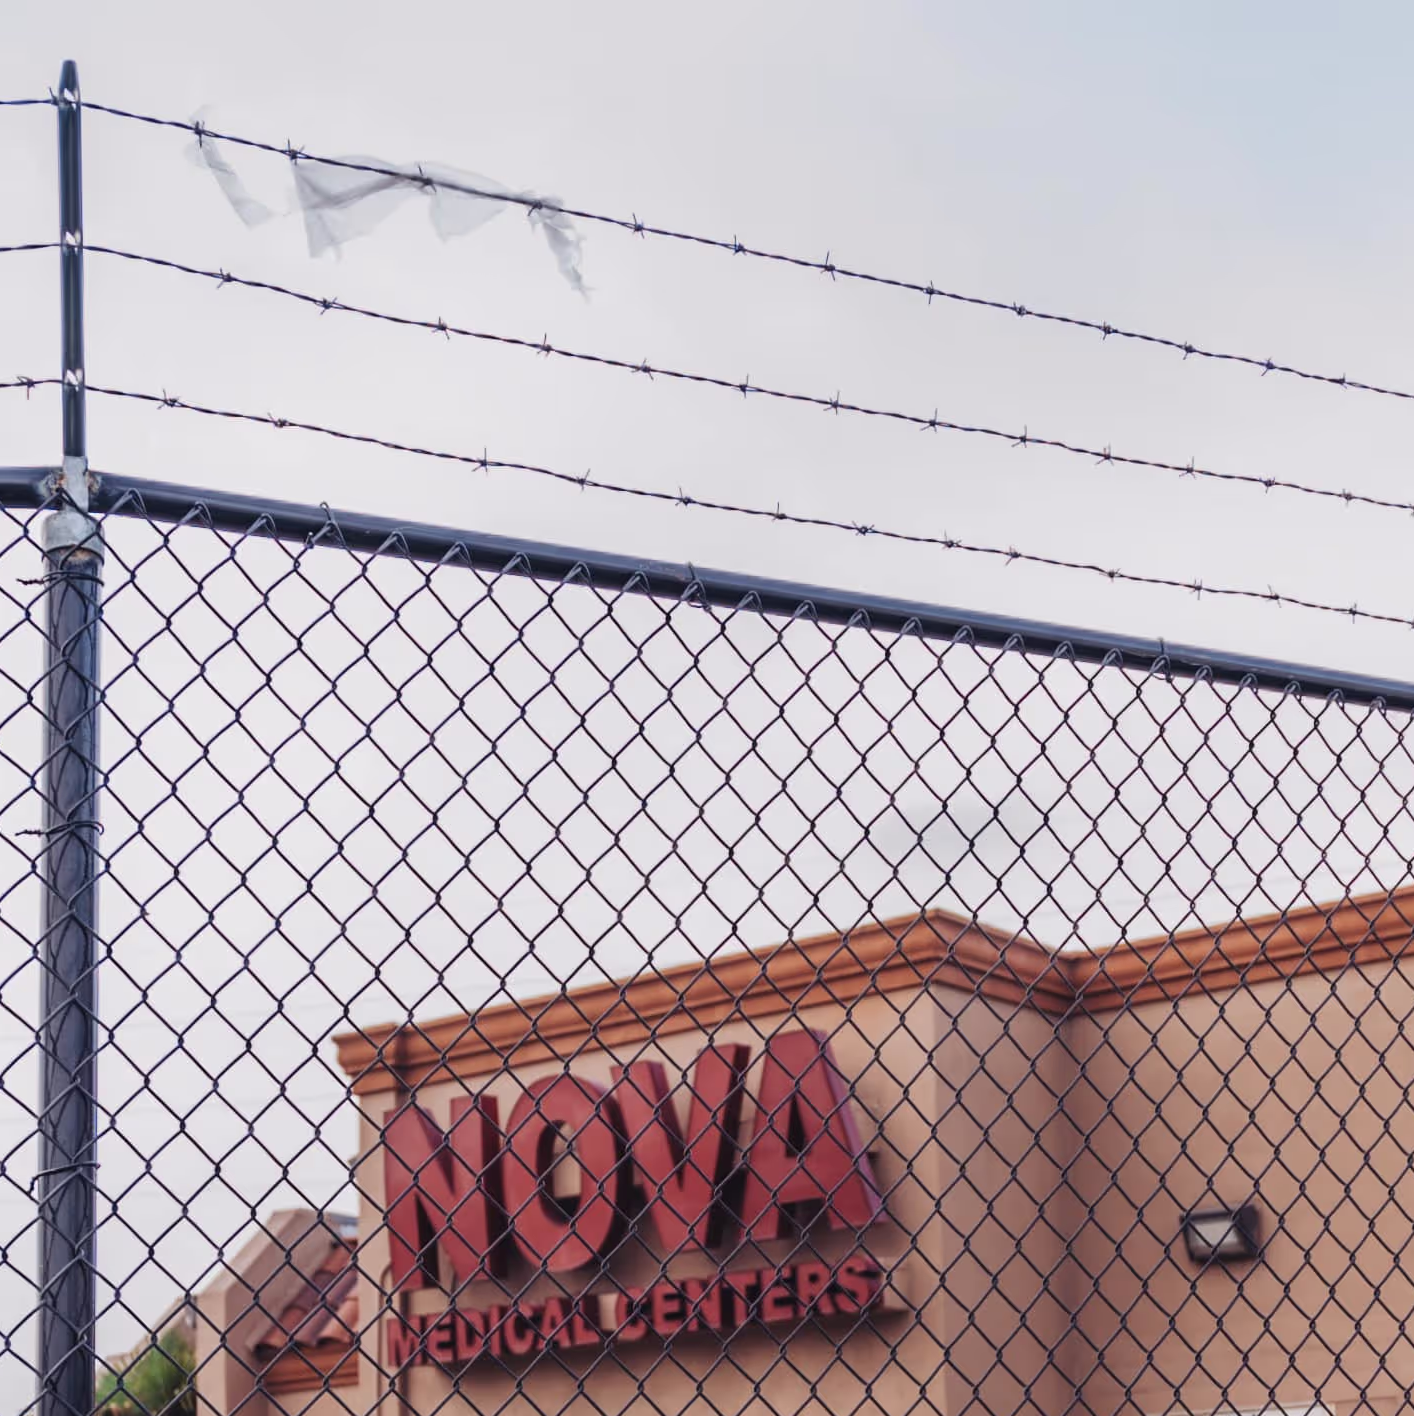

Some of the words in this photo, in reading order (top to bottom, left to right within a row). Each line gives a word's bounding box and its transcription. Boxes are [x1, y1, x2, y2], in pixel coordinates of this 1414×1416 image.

[383, 1029, 883, 1288] NOVA
[388, 1299, 599, 1366] MEDICAL
[614, 1256, 872, 1340] CENTERS
